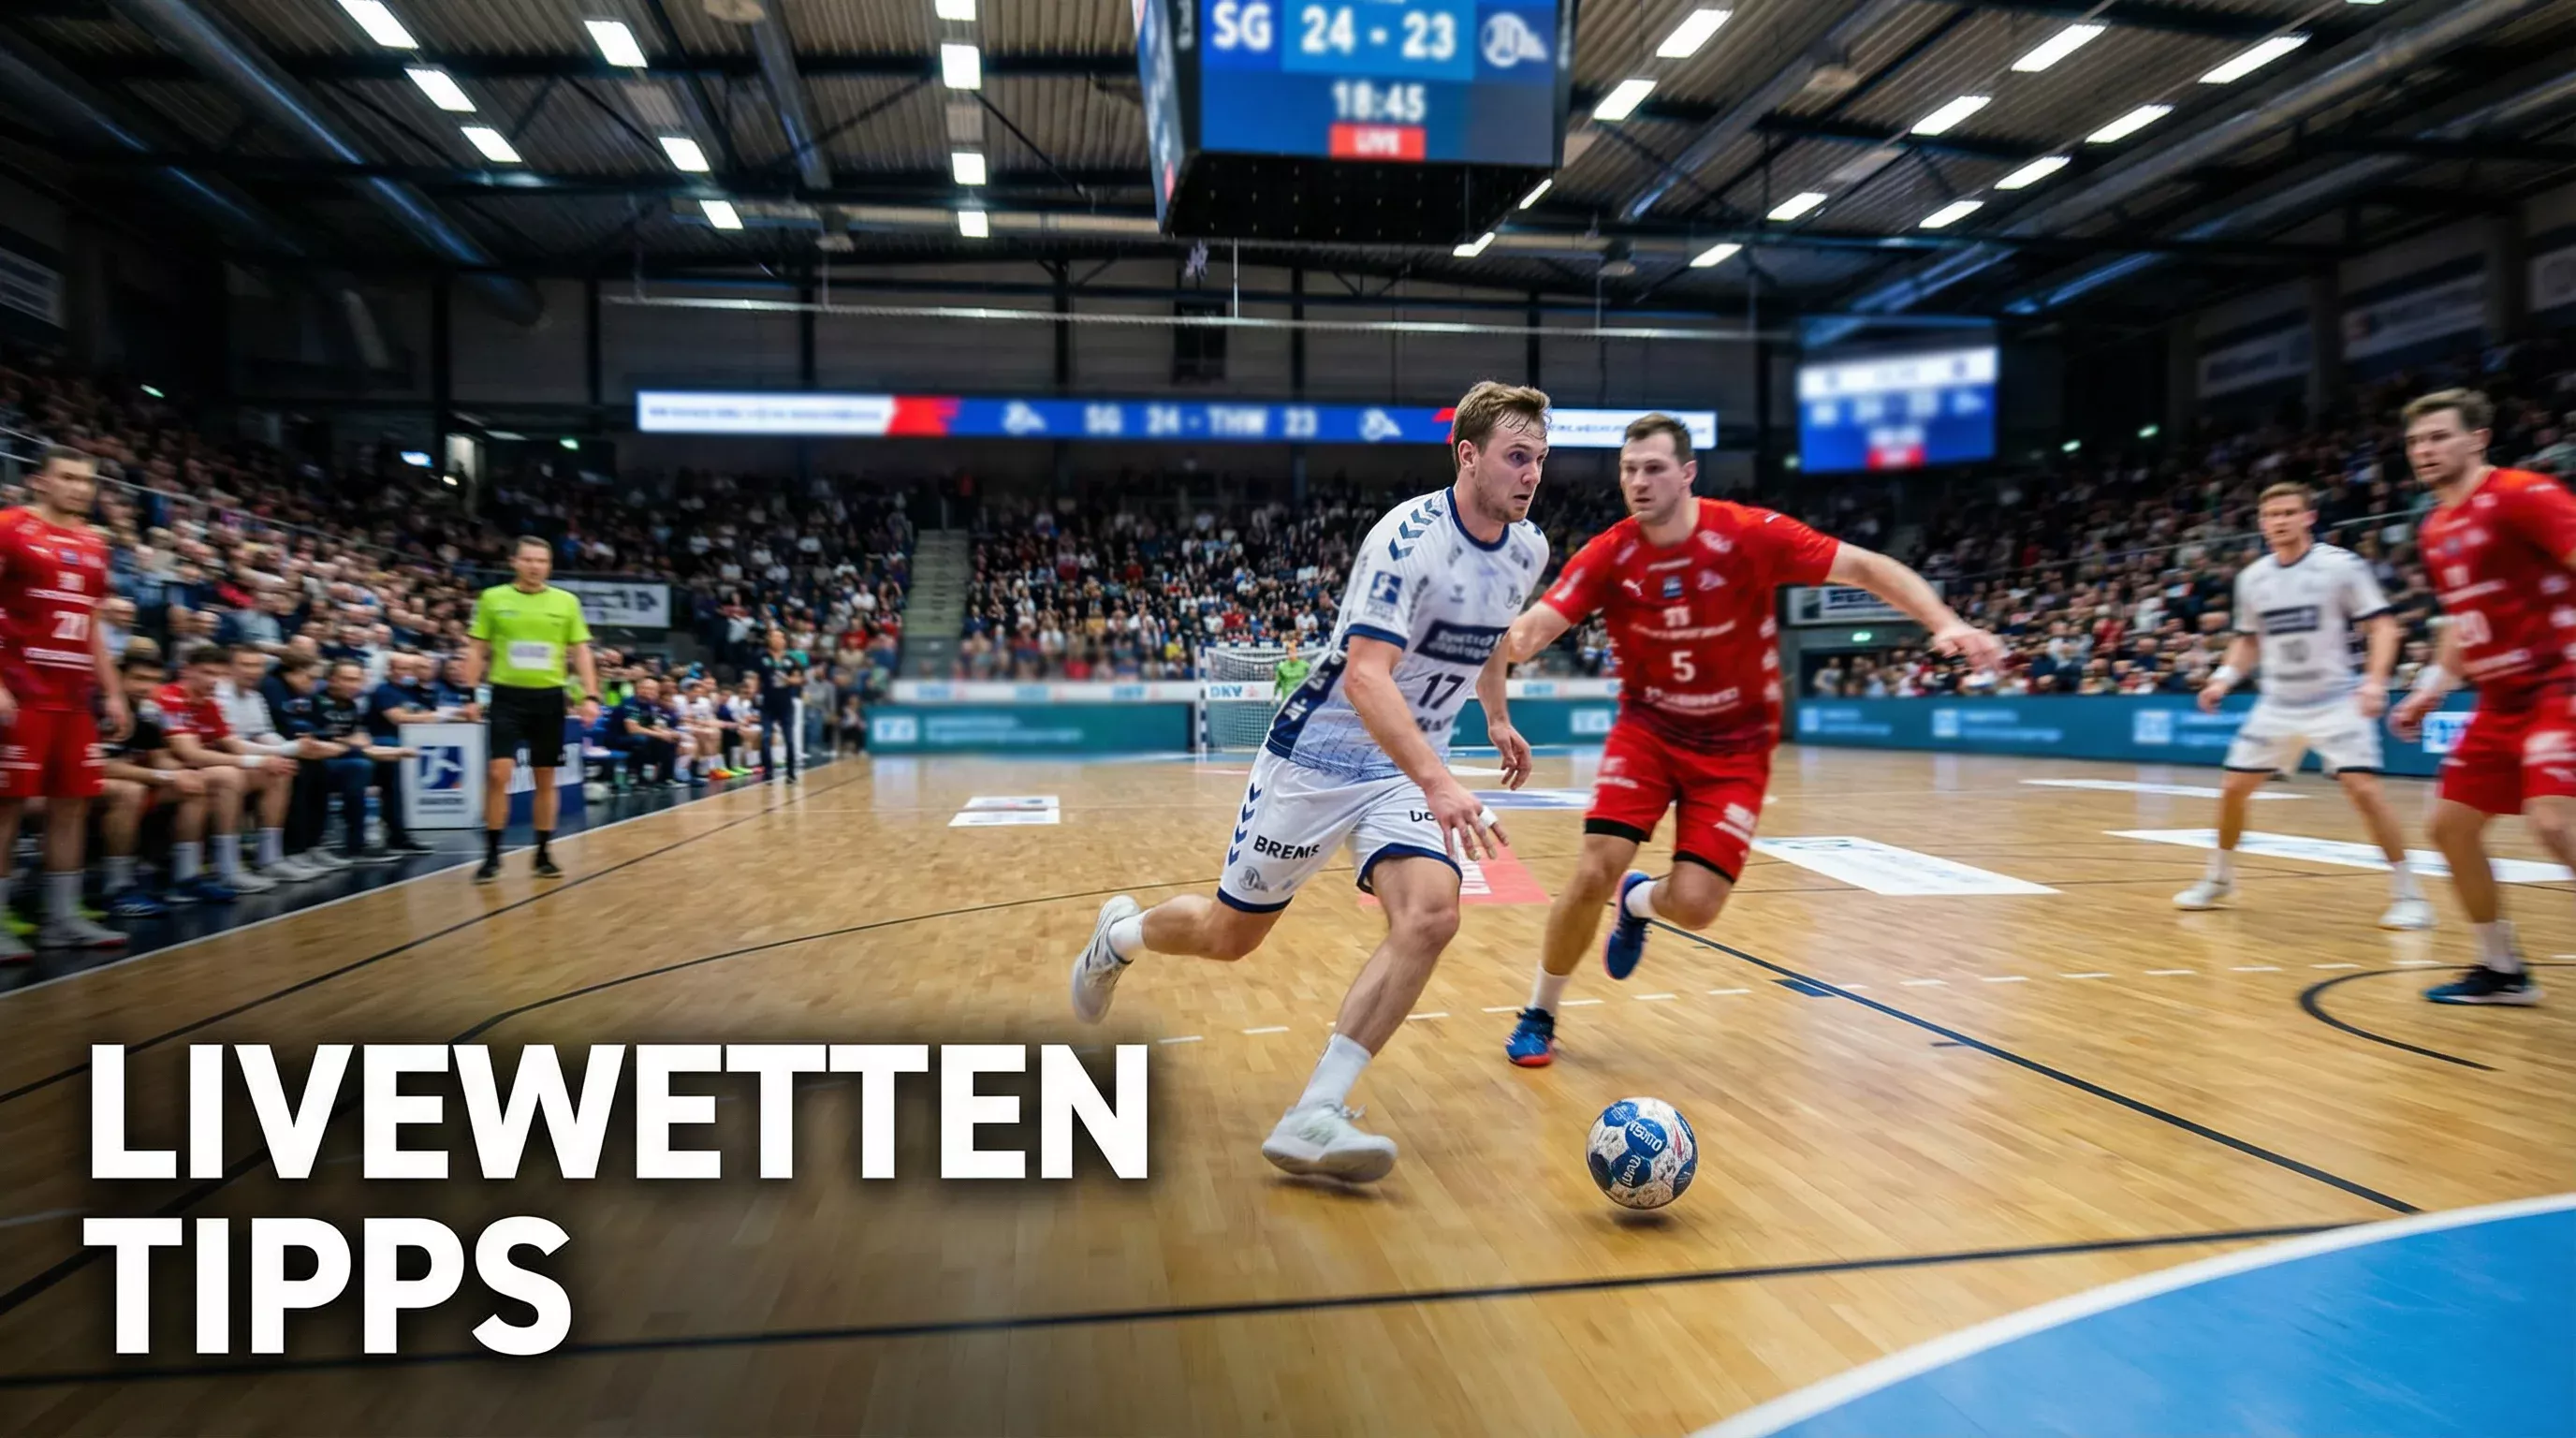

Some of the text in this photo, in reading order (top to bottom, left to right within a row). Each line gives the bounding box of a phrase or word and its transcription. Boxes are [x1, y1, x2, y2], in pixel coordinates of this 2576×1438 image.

[1212, 2, 1273, 51] SG
[1300, 8, 1355, 54] 24
[1402, 10, 1456, 61] 23
[1331, 81, 1426, 123] 18:45
[1354, 128, 1400, 154] LIVE
[1085, 404, 1122, 434] SG
[1147, 404, 1180, 436] 24
[1208, 404, 1267, 437] THW
[1671, 651, 1696, 682] 5
[1209, 684, 1243, 697] DKV
[1417, 672, 1466, 711] 17
